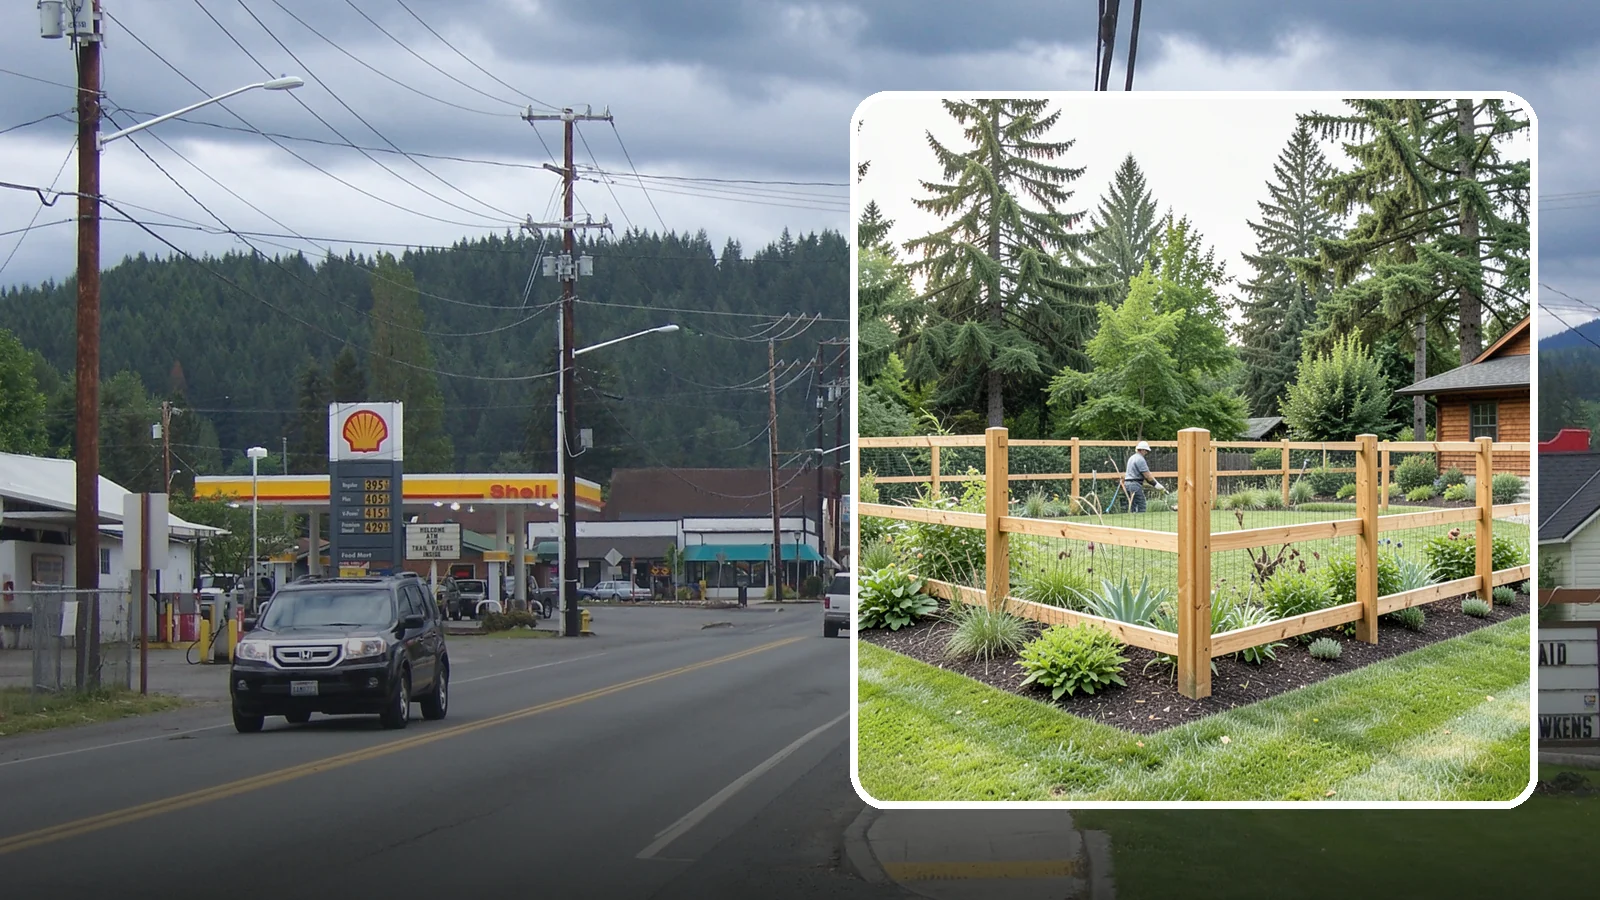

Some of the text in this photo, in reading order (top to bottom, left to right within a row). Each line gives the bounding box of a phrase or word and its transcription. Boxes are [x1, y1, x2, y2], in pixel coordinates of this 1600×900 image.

[366, 480, 383, 490] 395
[490, 484, 547, 499] Shell
[365, 494, 383, 504] 405
[365, 508, 383, 518] 415
[365, 522, 383, 532] 429
